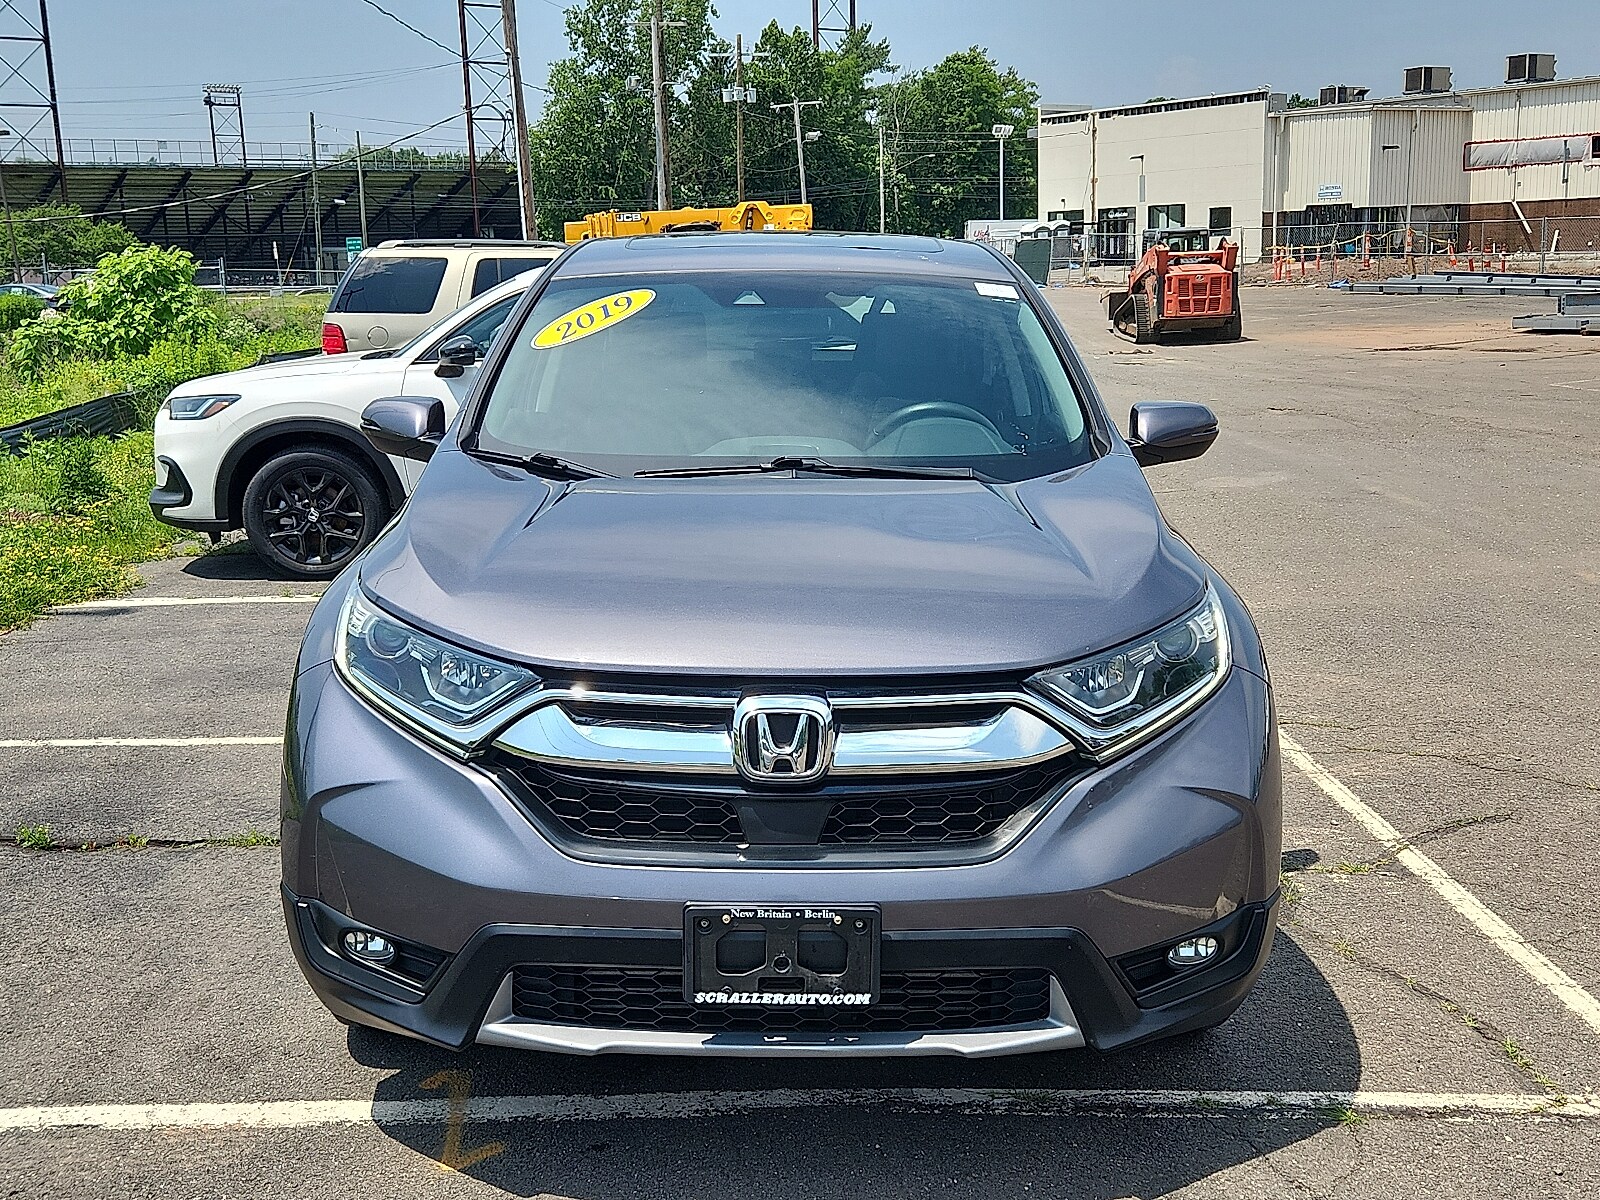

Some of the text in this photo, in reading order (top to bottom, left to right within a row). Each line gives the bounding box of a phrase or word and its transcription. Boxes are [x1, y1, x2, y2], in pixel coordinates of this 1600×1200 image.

[616, 213, 641, 222] JCB
[556, 296, 633, 341] 2019
[731, 909, 836, 919] New Britain Berlin
[694, 992, 872, 1005] SCHALLERAUTO.COM
